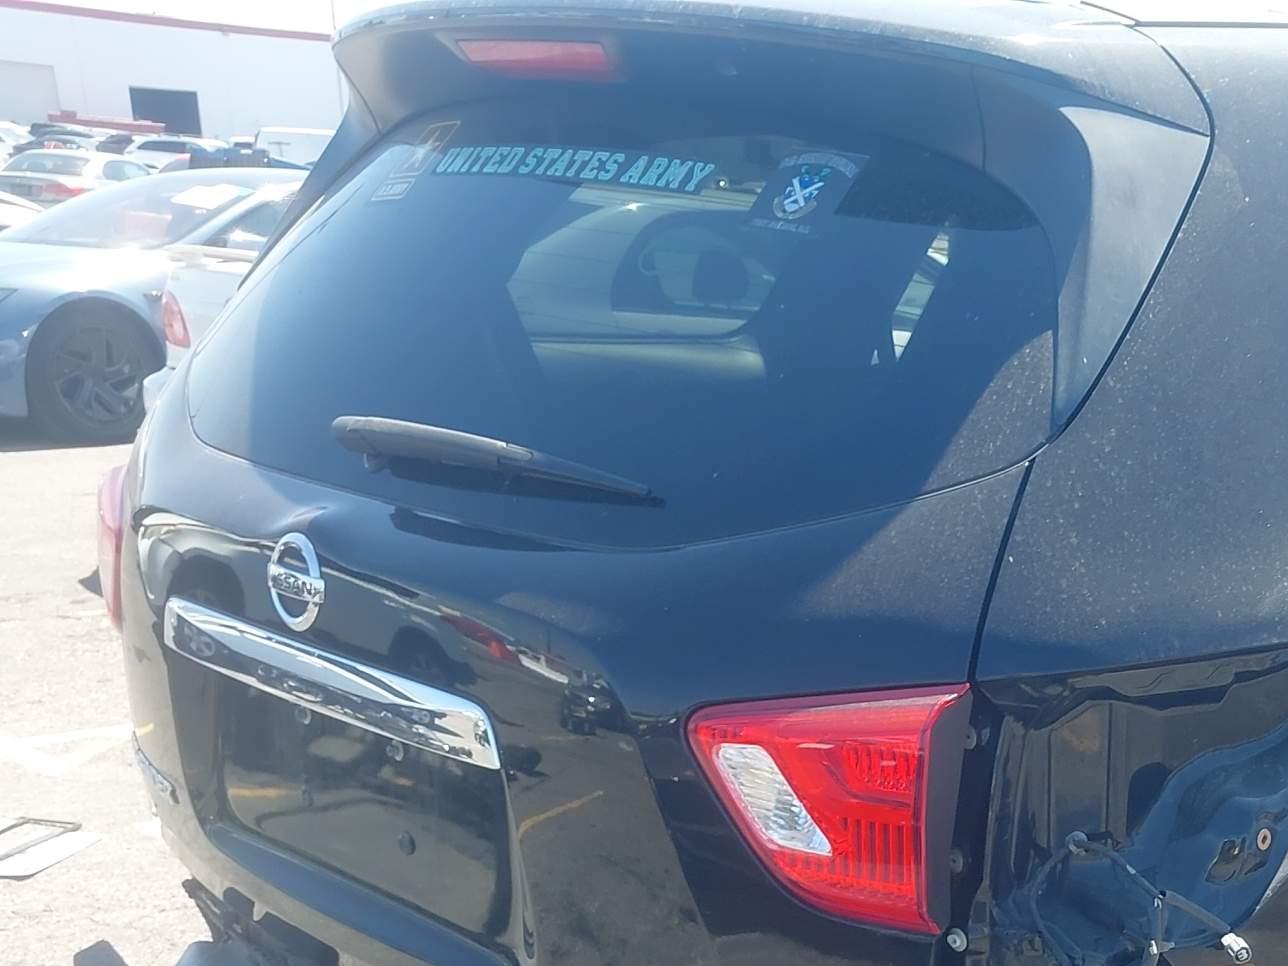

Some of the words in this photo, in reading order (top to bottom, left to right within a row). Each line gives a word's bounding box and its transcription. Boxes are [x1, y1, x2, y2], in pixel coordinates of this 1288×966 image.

[435, 146, 526, 174] UNITED
[518, 147, 625, 182] STATES
[619, 155, 716, 192] ARMY
[270, 572, 314, 597] SSAN
